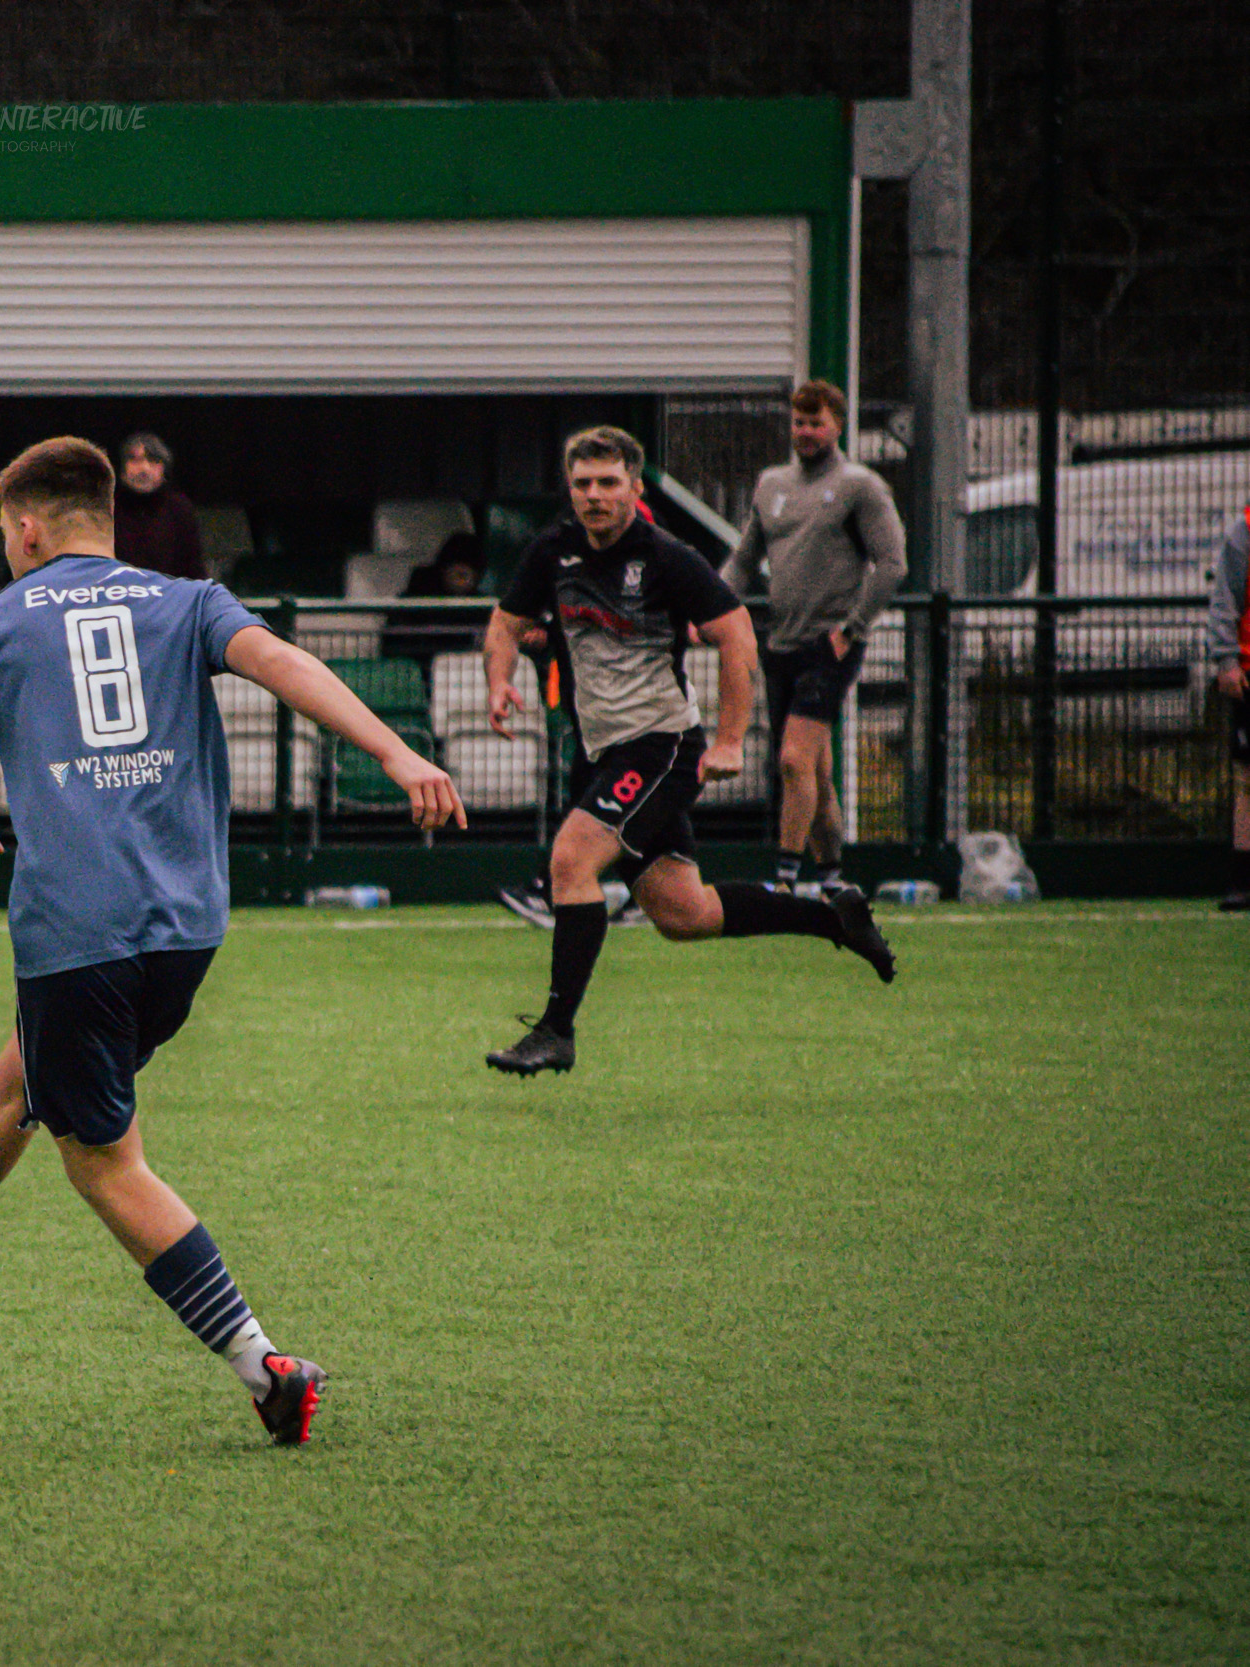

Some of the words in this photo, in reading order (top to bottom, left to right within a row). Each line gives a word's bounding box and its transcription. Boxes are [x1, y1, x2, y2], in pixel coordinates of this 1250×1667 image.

[24, 584, 163, 608] Everest
[64, 604, 149, 748] 8
[75, 756, 102, 774] W2
[103, 749, 175, 771] WINDOW
[94, 767, 162, 789] SYSTEMS
[613, 770, 643, 803] 8
